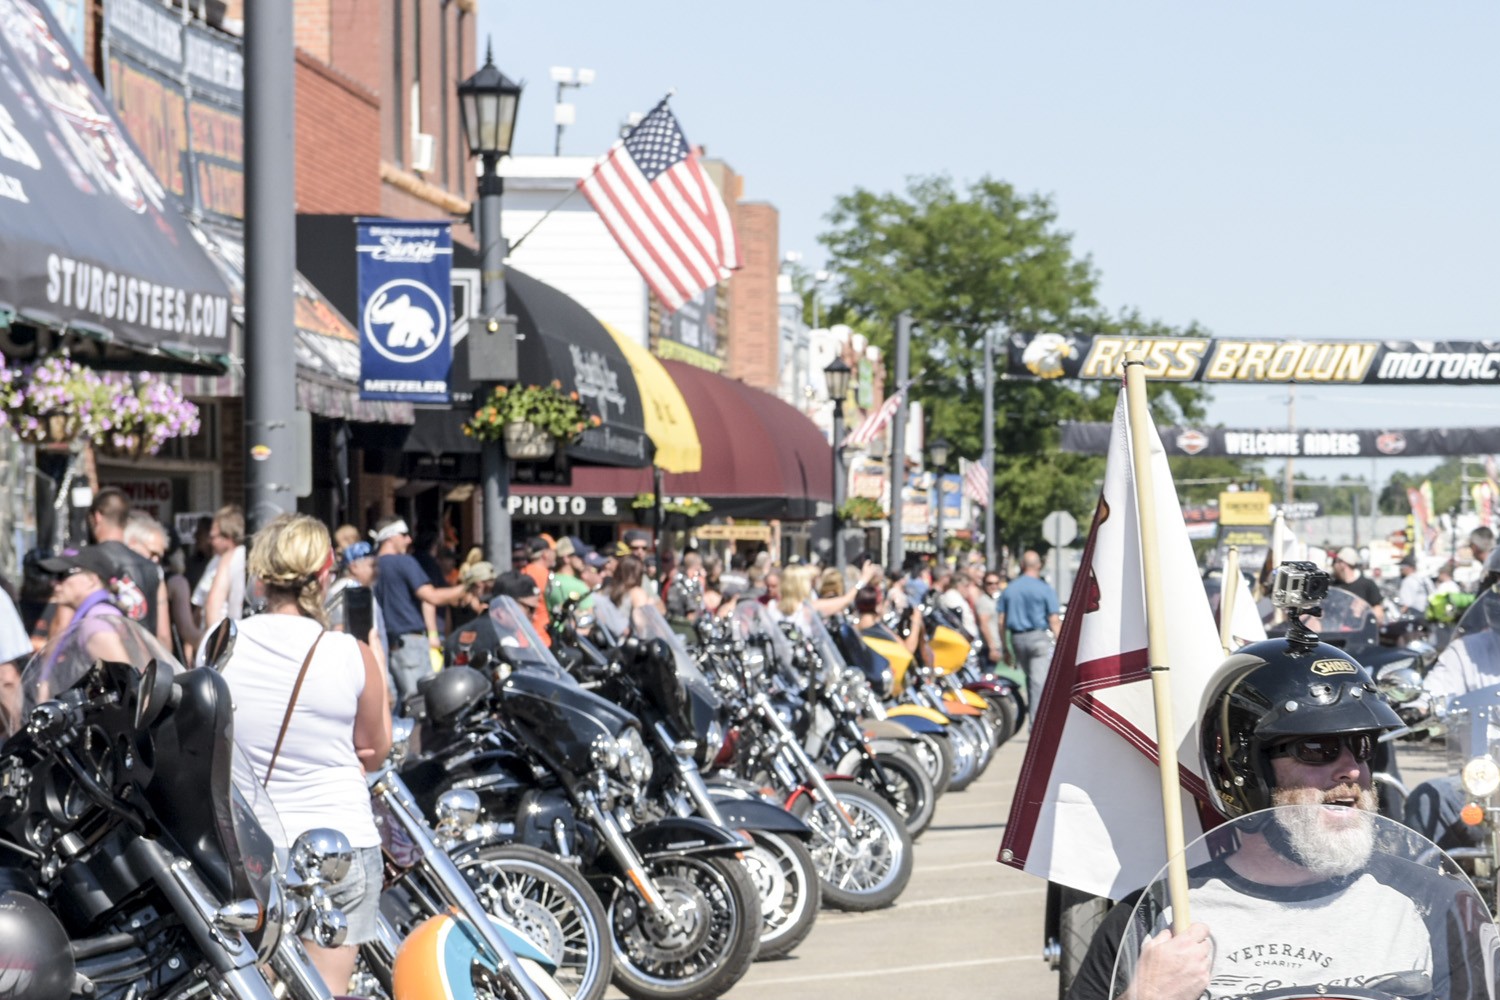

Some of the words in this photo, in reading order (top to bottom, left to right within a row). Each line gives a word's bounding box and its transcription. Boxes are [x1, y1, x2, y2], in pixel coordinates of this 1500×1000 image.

[46, 253, 228, 338] STURGISTEES.COM
[1203, 339, 1380, 383] BROWN
[364, 380, 447, 393] METZELER
[1225, 432, 1299, 455] WELCOME
[1303, 432, 1361, 455] RIDERS
[508, 497, 587, 515] PHOTO
[1226, 943, 1333, 968] VETERANS
[1255, 960, 1303, 968] CHARITY
